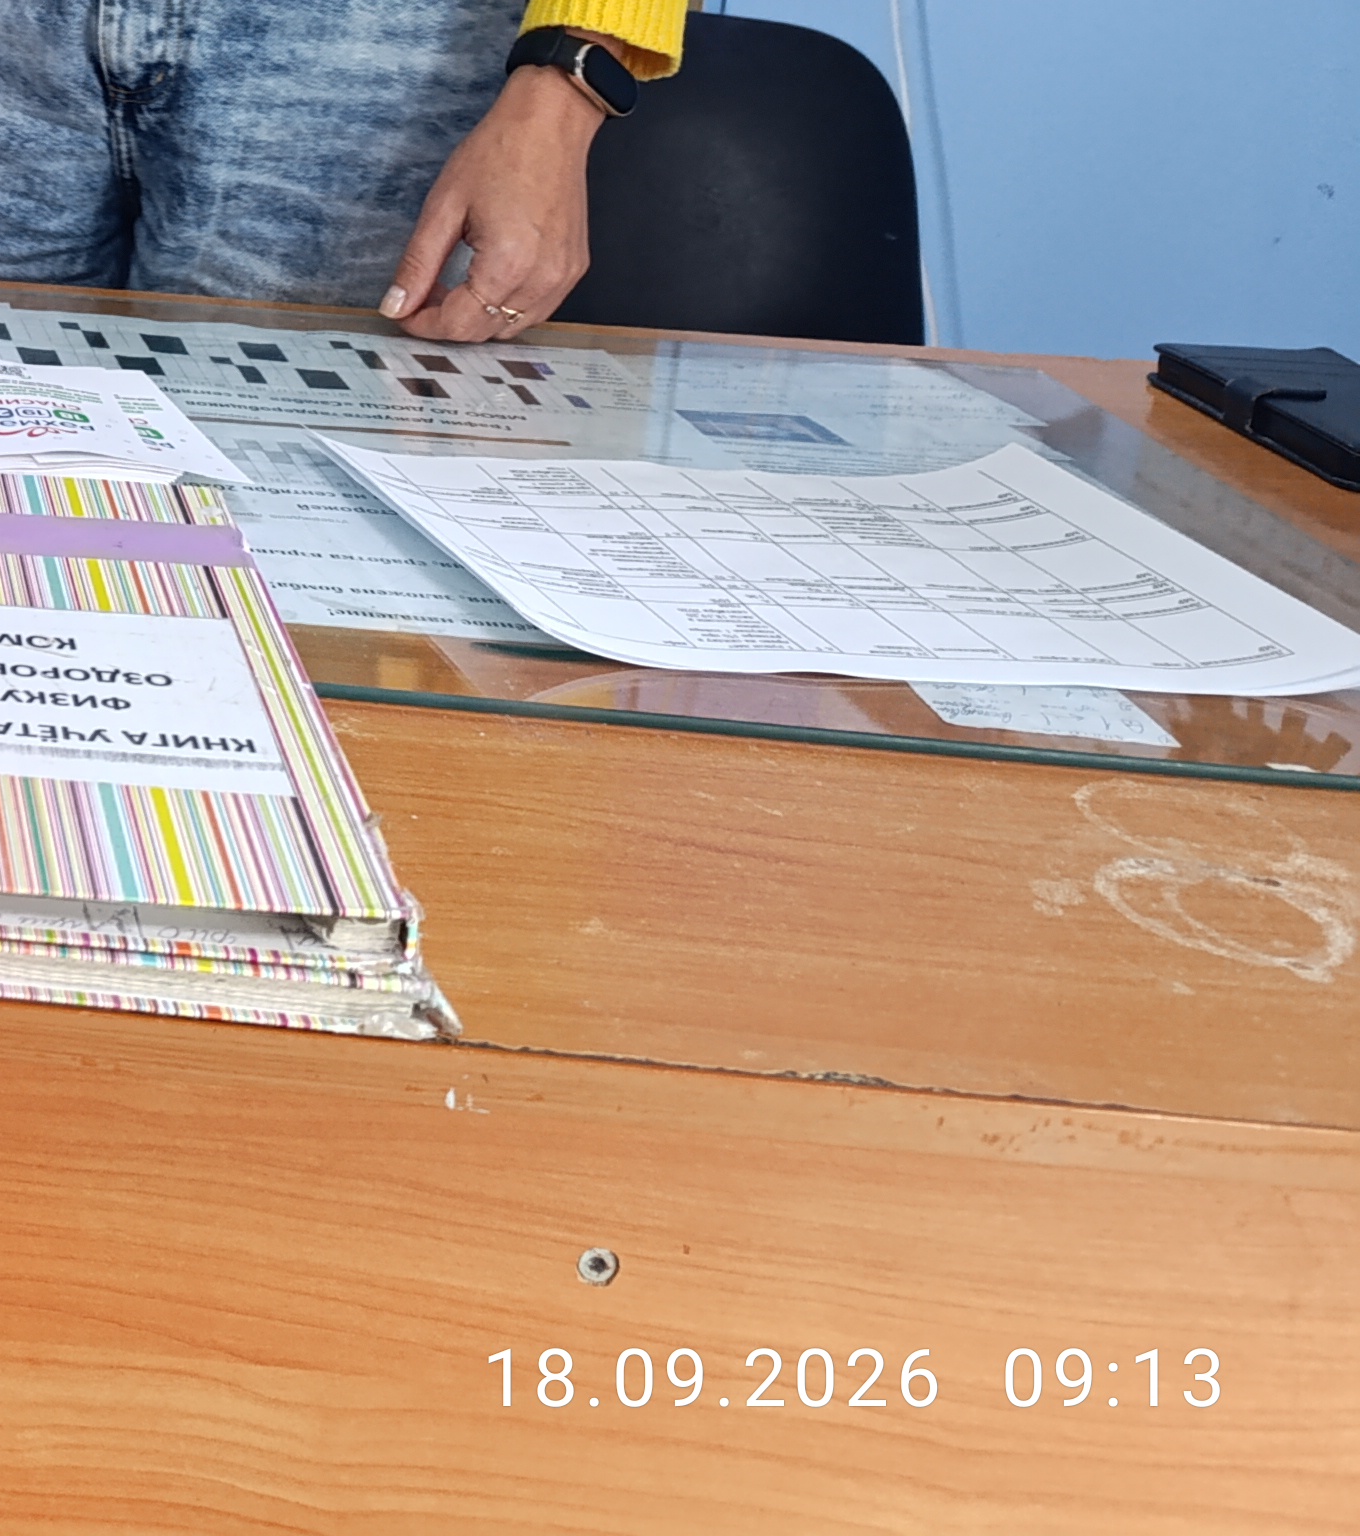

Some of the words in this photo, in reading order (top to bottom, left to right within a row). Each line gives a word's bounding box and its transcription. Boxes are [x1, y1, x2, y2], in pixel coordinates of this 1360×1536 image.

[242, 485, 336, 498] сентябрь
[330, 553, 427, 568] сработка
[268, 581, 344, 594] бомба!
[350, 586, 455, 601] заложена
[119, 728, 258, 755] КНИГА
